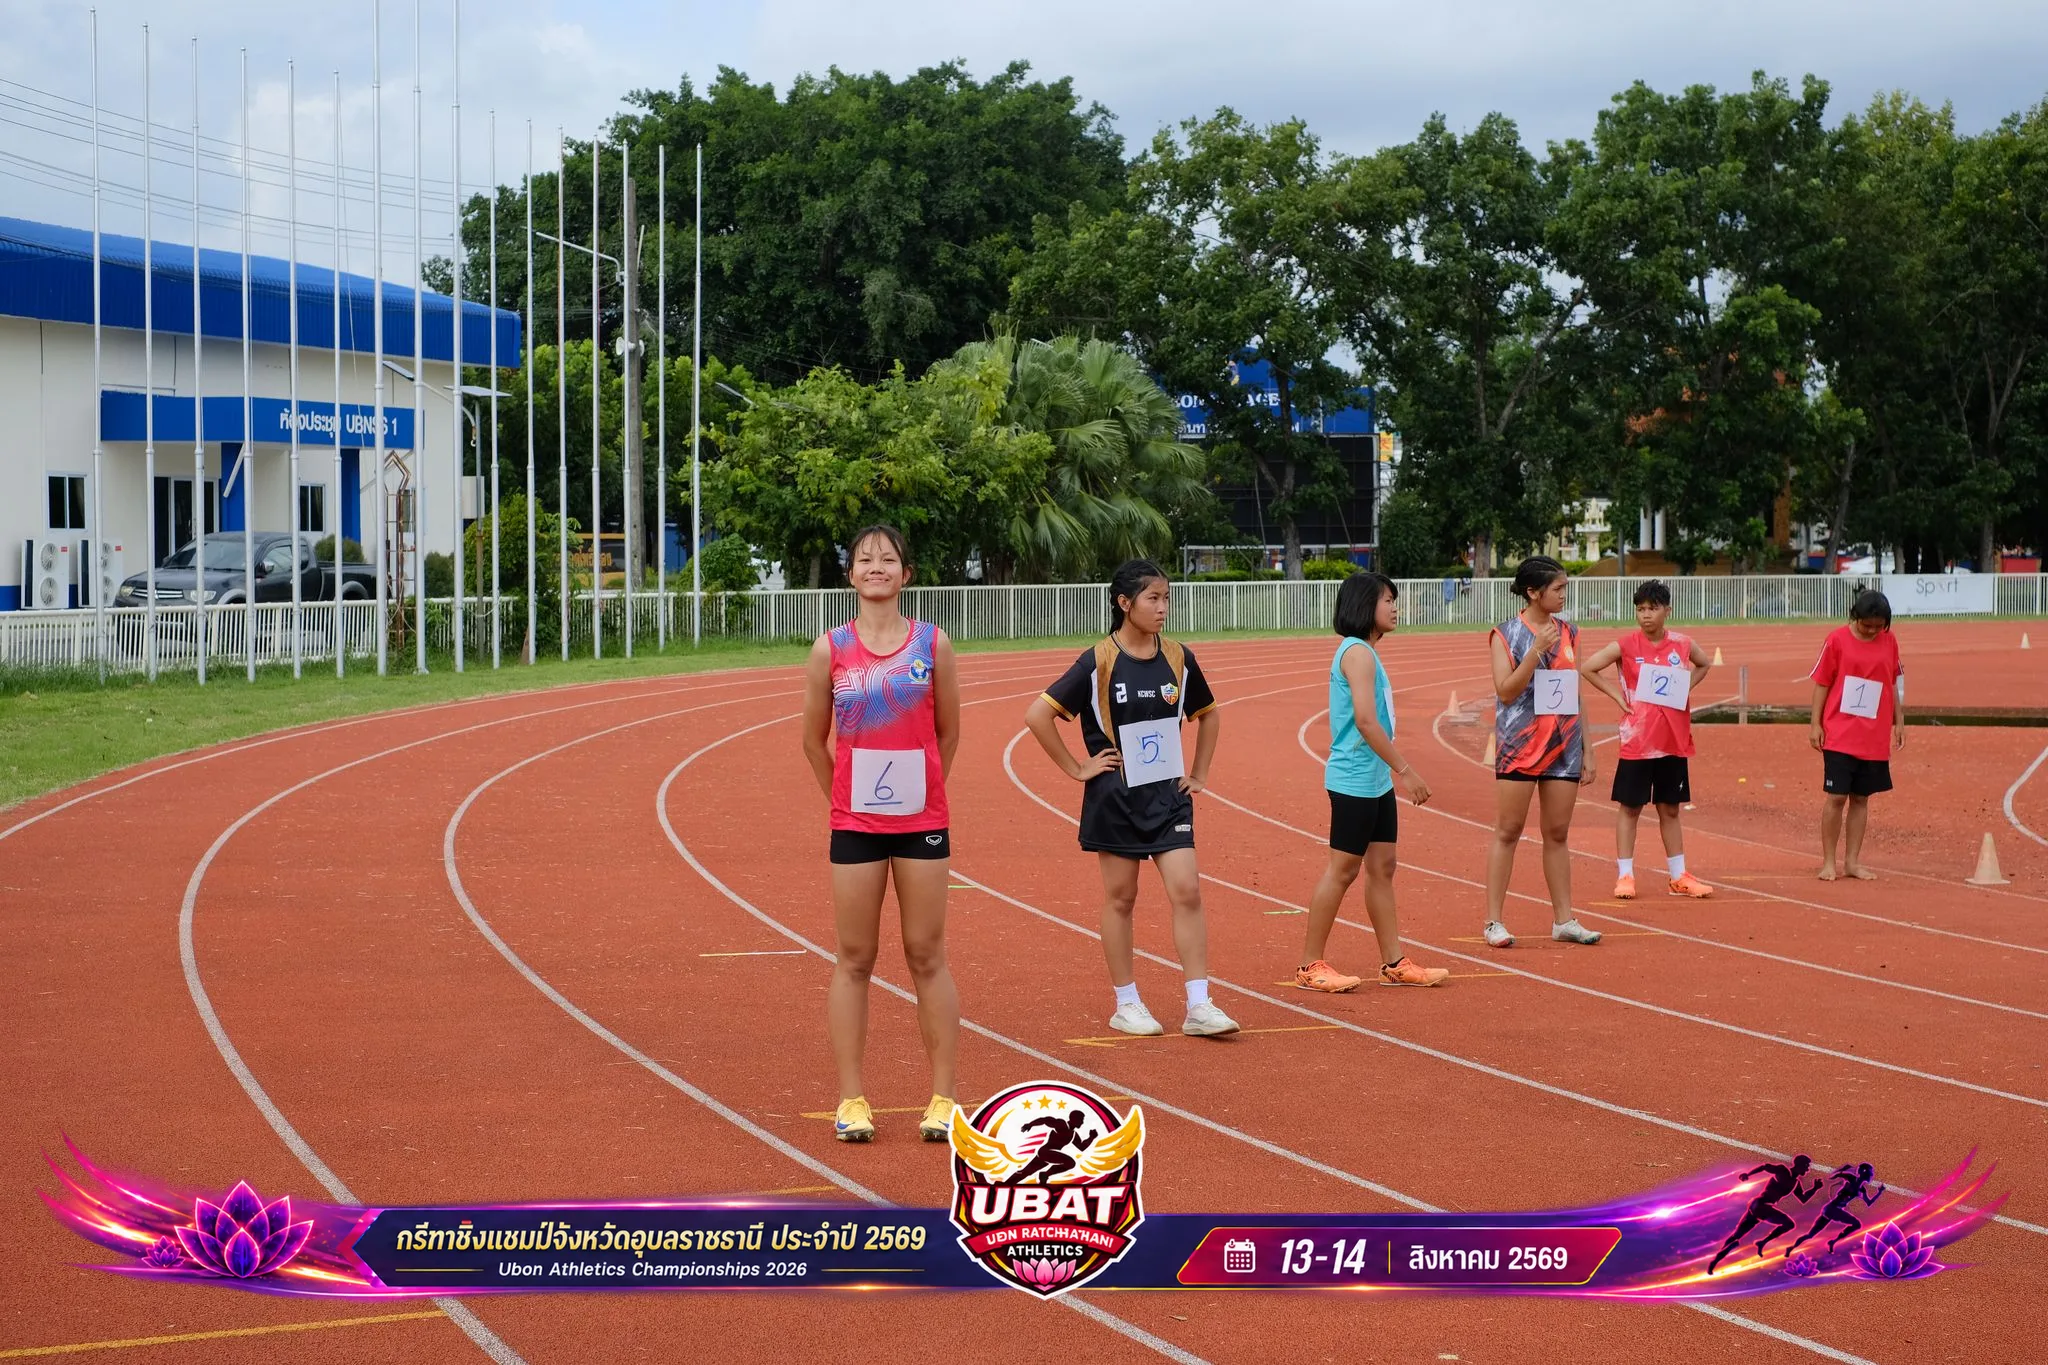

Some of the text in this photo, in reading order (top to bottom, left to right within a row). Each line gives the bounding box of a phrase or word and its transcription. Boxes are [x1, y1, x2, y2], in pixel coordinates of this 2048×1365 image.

[391, 416, 398, 436] 1
[1115, 683, 1128, 704] 2
[1546, 678, 1564, 710] 3
[1654, 676, 1669, 696] 2
[1850, 683, 1867, 708] 1
[1141, 734, 1160, 763] 5
[874, 760, 894, 801] 6
